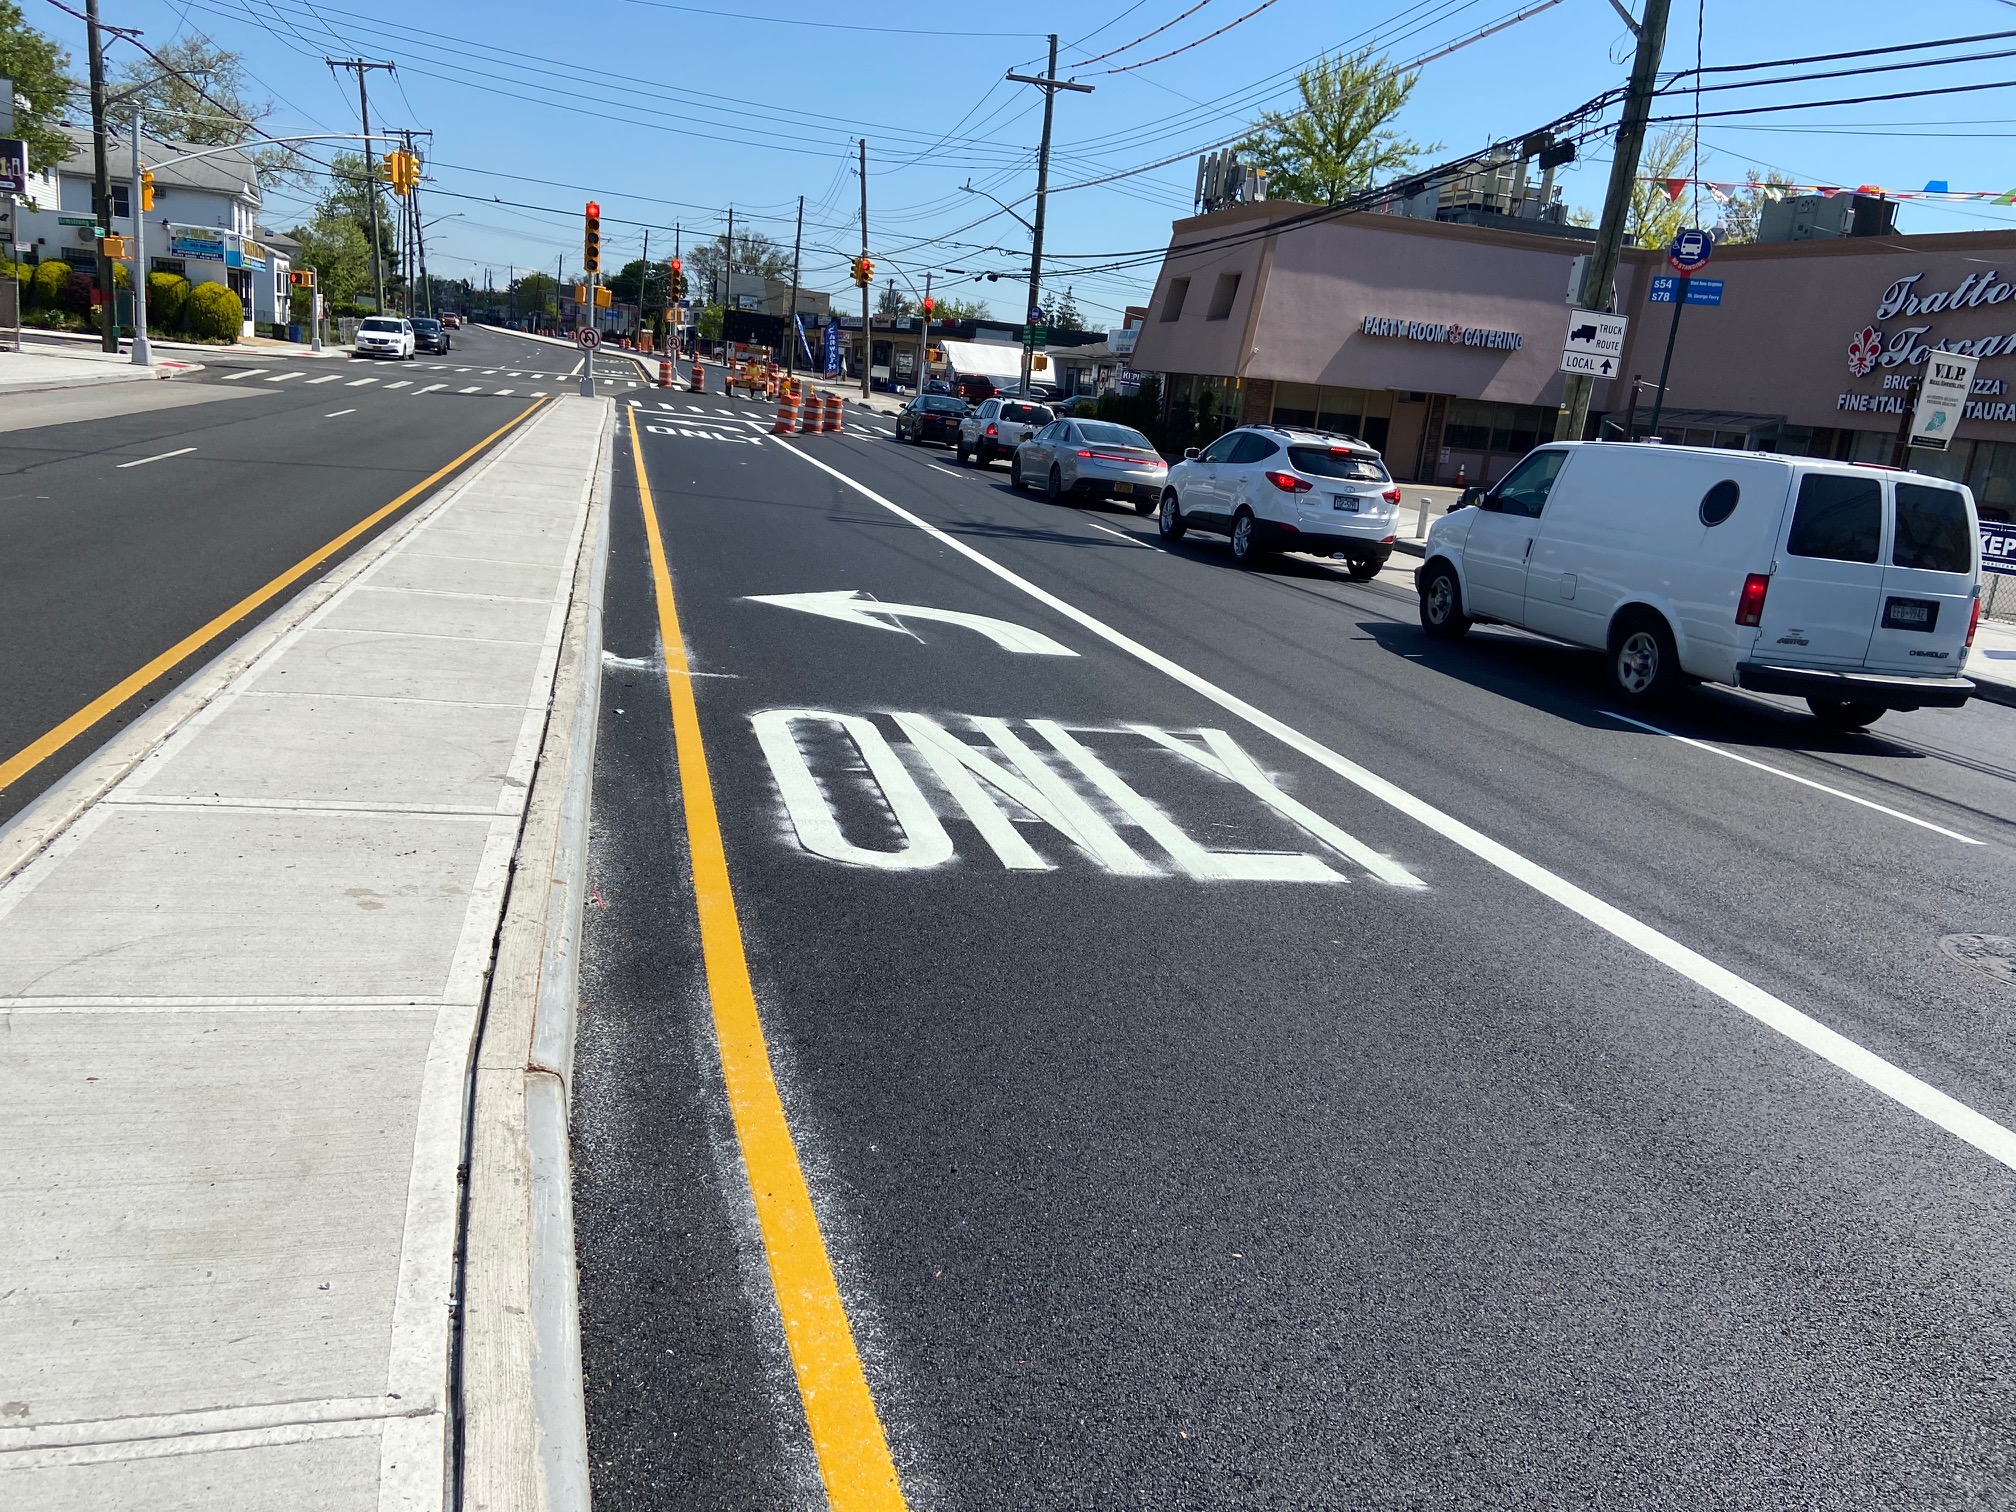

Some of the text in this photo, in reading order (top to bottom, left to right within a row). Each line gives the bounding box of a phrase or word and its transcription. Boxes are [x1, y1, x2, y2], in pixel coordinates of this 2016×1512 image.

[1678, 259, 1706, 270] STANDING
[1876, 271, 2016, 320] Tratto
[1363, 316, 1524, 350] PARTY ROOM CATERING
[1600, 323, 1623, 335] TRUCK
[1596, 339, 1620, 351] ROUTE
[1566, 355, 1595, 370] LOCAL
[1883, 374, 2000, 395] BRIC IZZA
[1837, 394, 1869, 412] FINE
[1965, 401, 2016, 421] TAURA
[646, 426, 763, 445] ONLY
[1909, 650, 1949, 659] CHEVROLET
[750, 708, 1428, 888] ONLY
